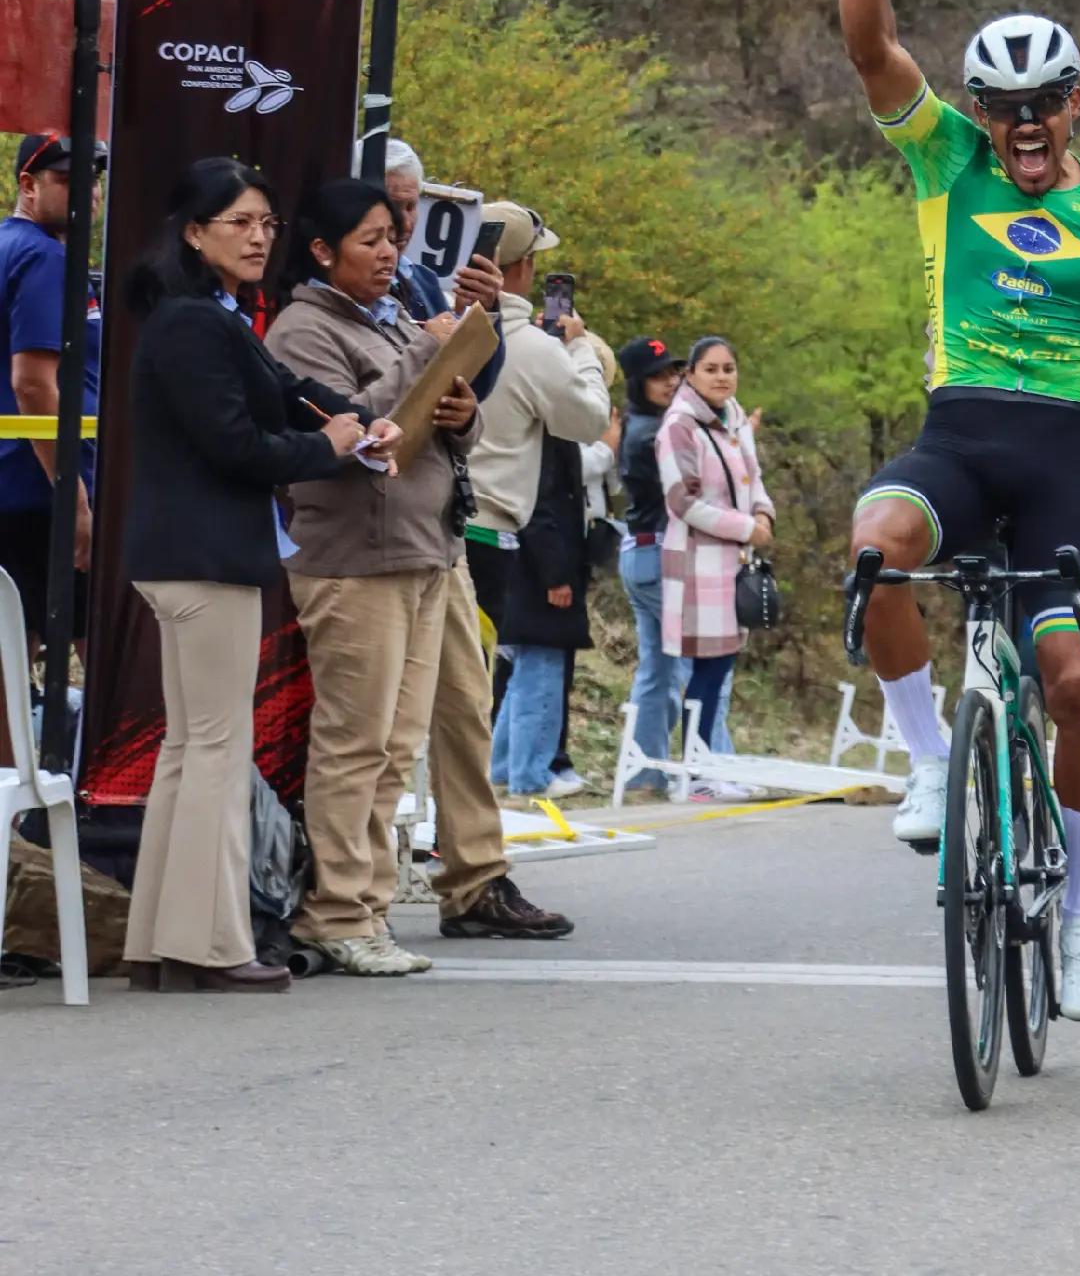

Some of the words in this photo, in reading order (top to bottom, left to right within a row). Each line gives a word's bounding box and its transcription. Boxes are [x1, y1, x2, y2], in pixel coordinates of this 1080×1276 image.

[159, 42, 245, 63] COPACI
[204, 66, 244, 74] AMERICAN
[181, 80, 243, 88] CONFEDERATION
[421, 200, 464, 277] 9
